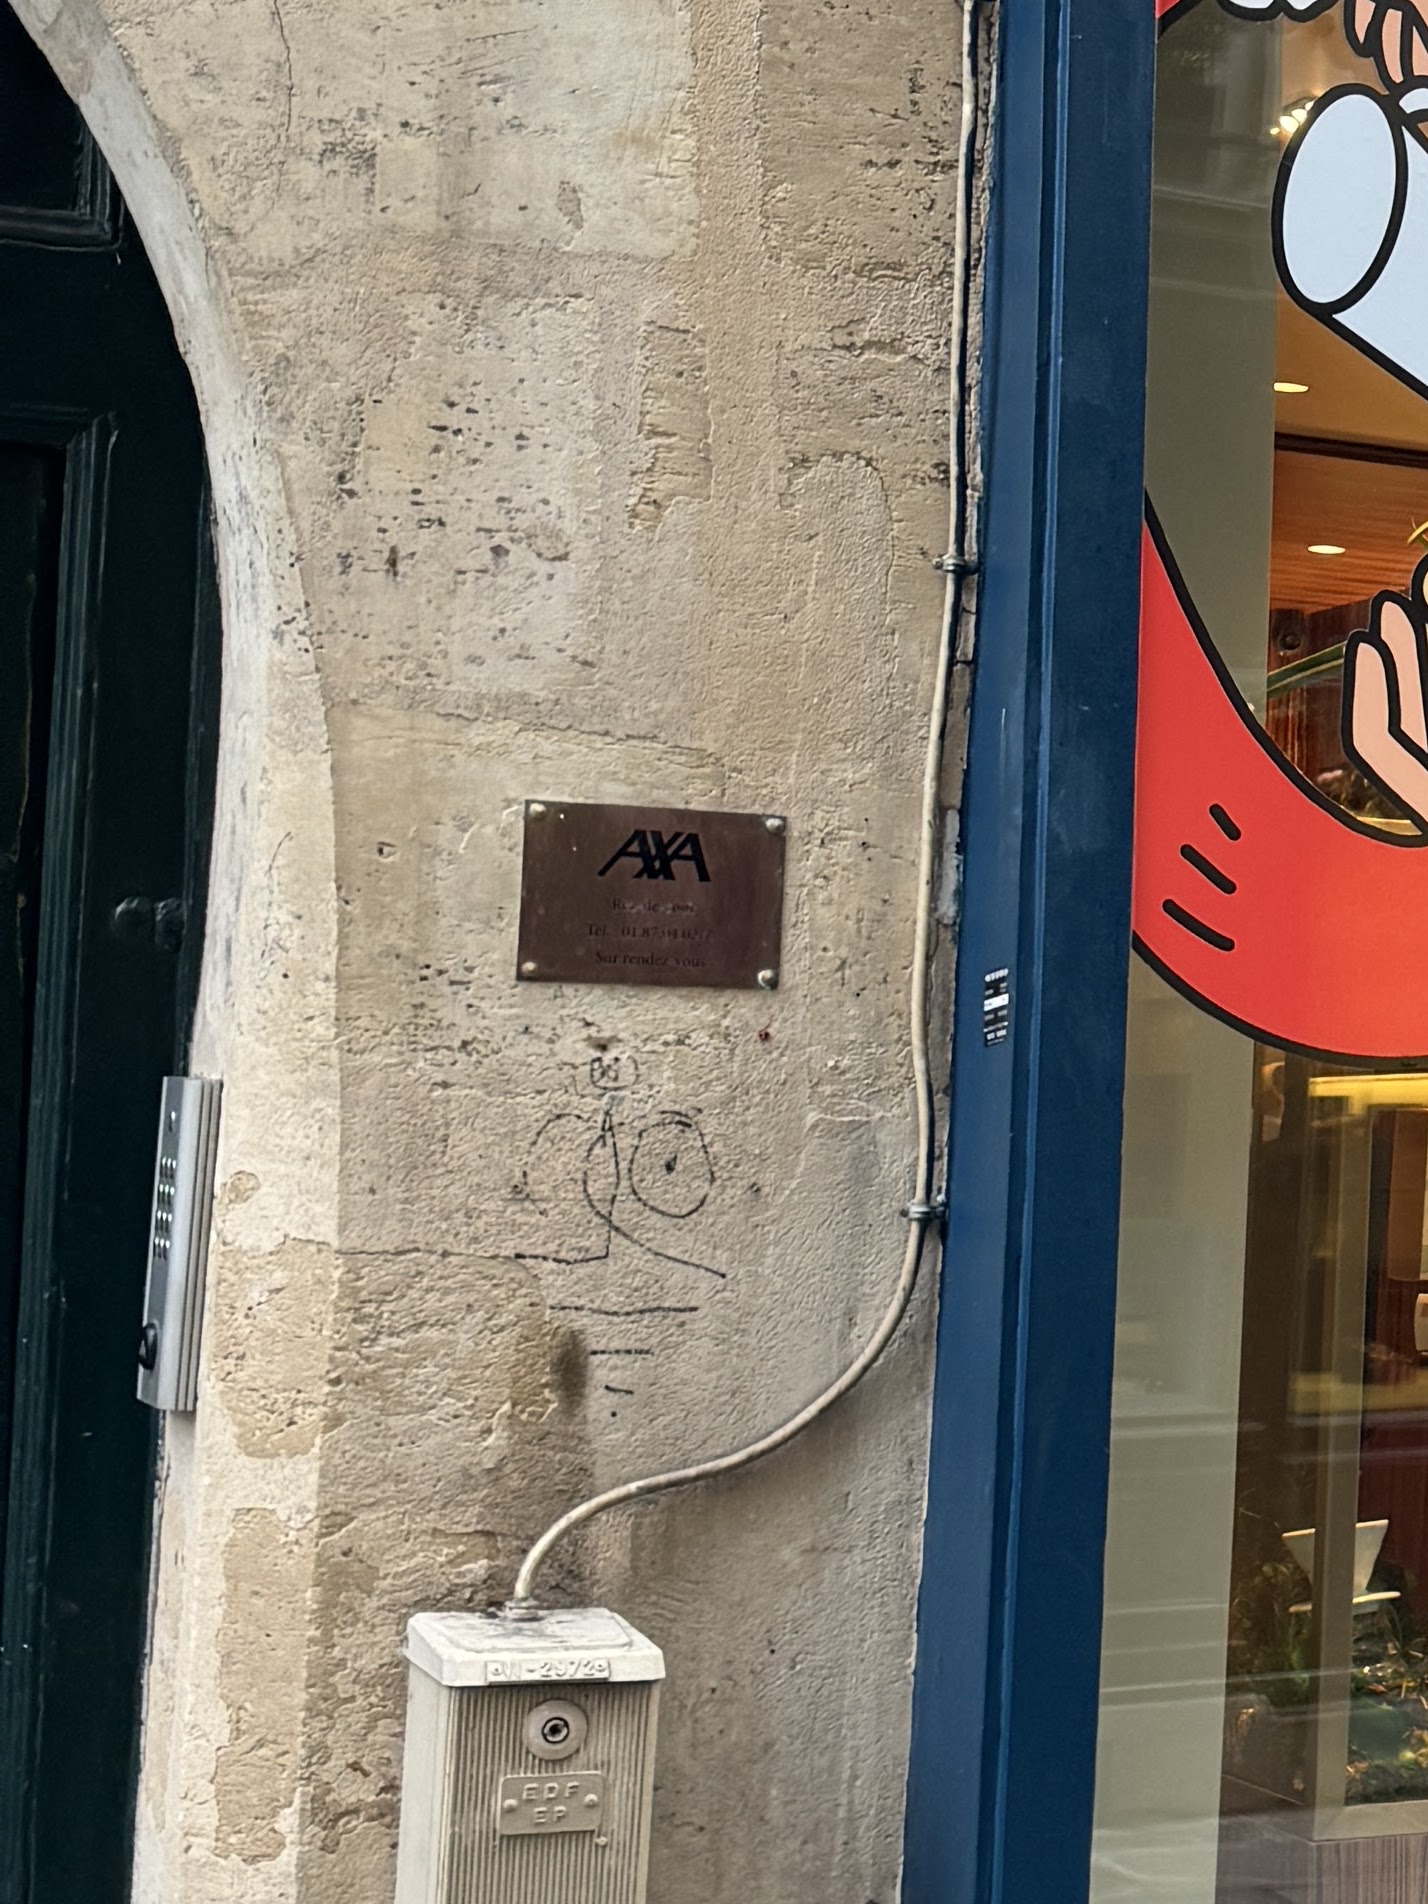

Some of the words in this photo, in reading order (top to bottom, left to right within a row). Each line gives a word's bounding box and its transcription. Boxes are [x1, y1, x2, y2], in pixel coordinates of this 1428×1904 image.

[597, 828, 712, 883] AXA
[522, 1780, 580, 1801] EDF
[533, 1805, 567, 1824] EP
